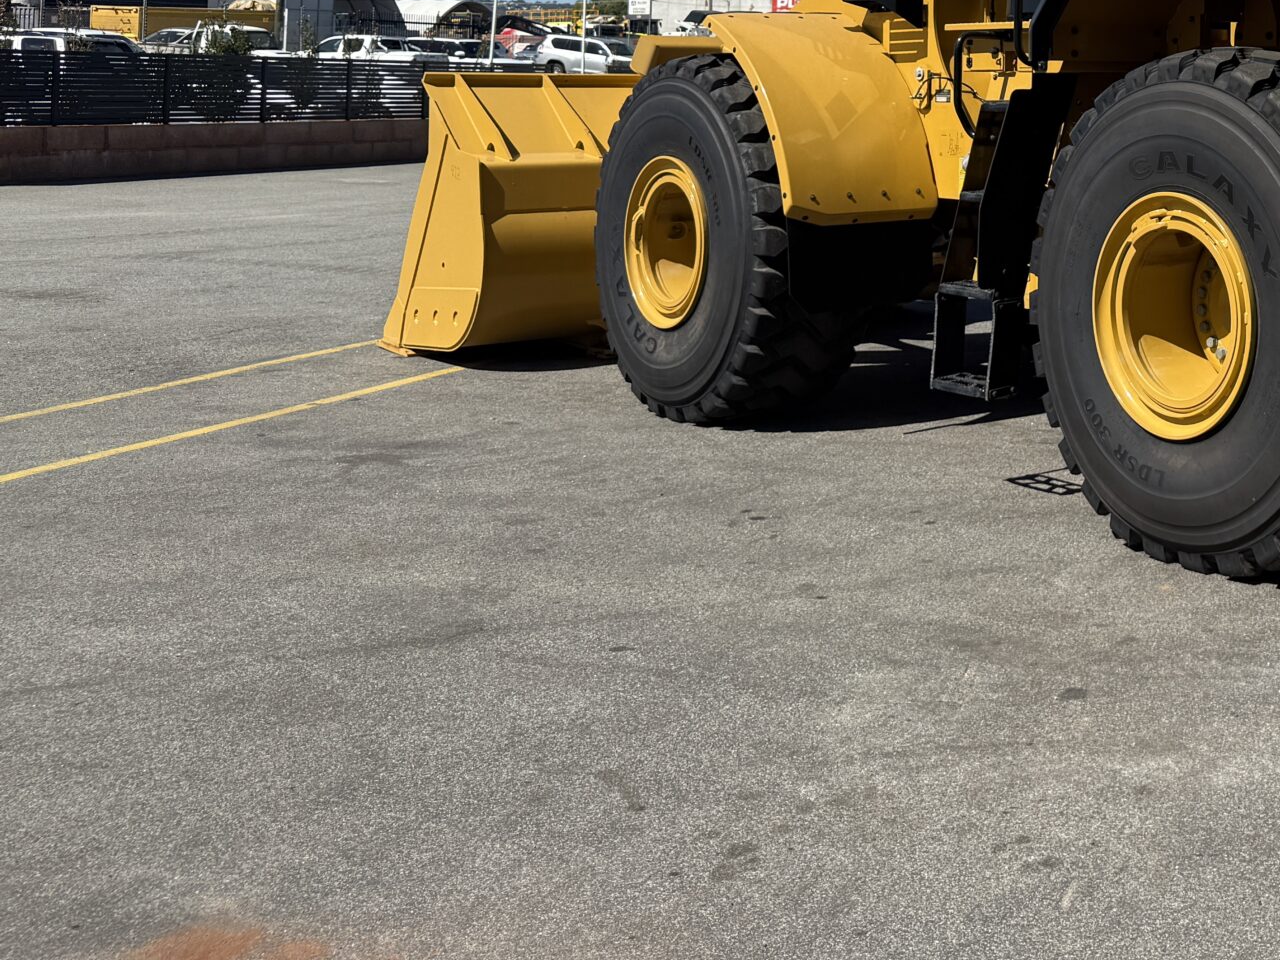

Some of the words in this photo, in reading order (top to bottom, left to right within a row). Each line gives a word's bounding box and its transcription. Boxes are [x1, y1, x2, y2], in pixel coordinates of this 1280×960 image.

[1129, 151, 1279, 279] GALAXY
[1083, 398, 1112, 442] 300
[1112, 443, 1167, 488] LDSR
